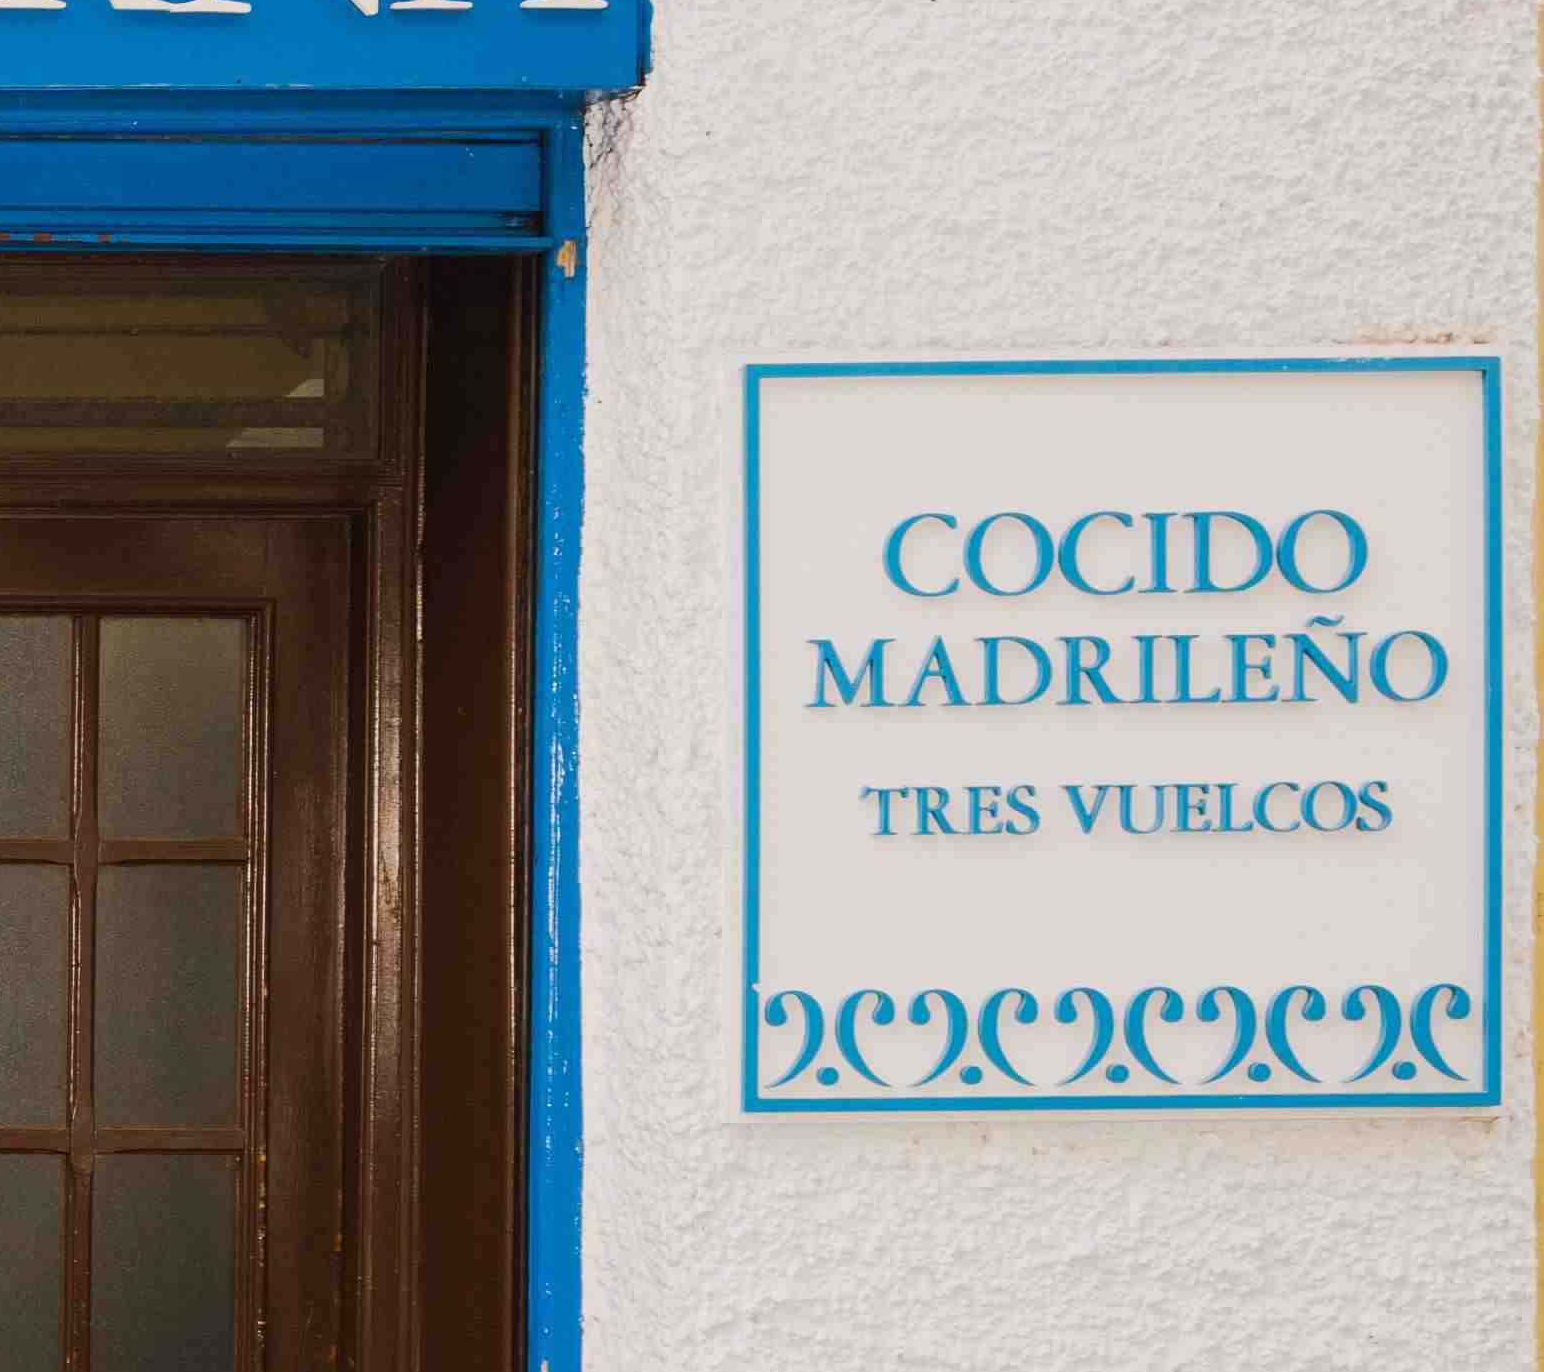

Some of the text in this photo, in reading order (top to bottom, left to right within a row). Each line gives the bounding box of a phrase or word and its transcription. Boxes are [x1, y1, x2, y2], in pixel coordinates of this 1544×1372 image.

[882, 509, 1371, 599] COCIDO
[805, 615, 1450, 709] MADRILEÑO
[860, 781, 1394, 837] TRES VUELCOS
